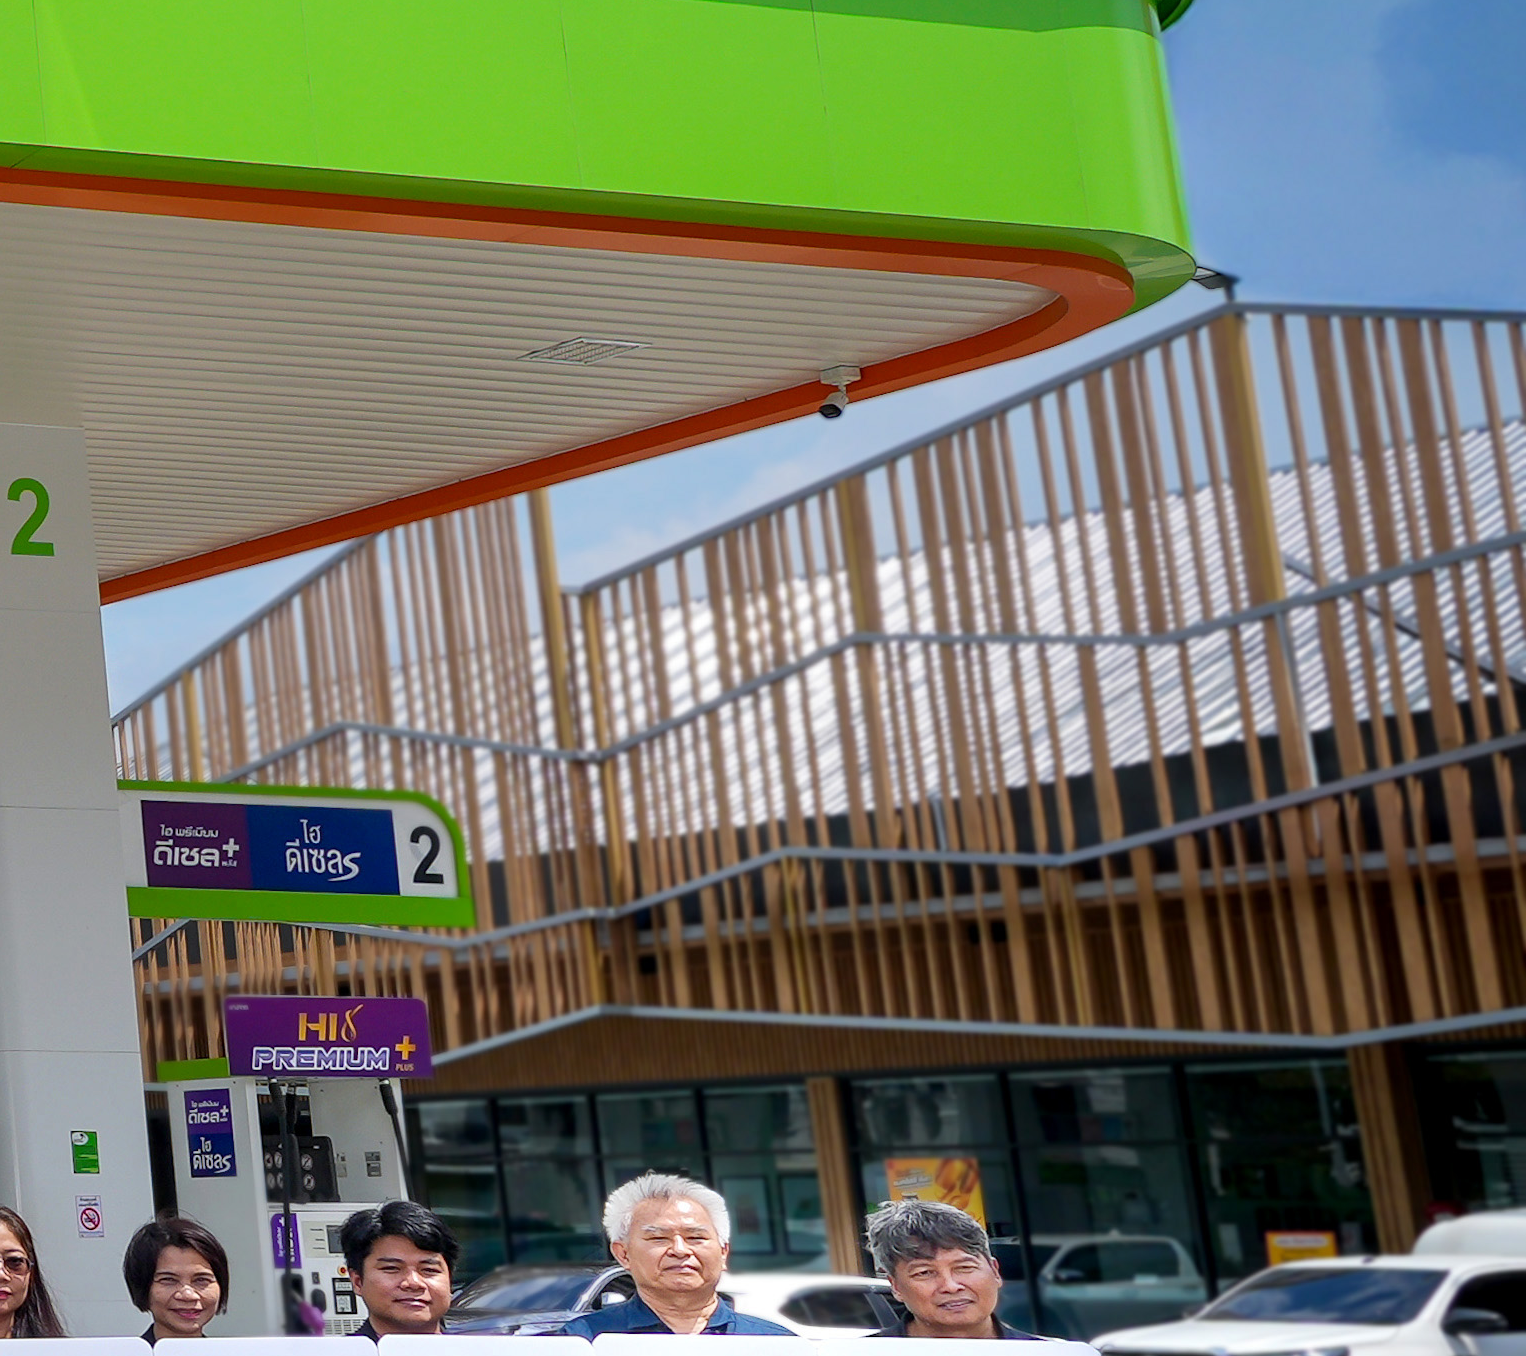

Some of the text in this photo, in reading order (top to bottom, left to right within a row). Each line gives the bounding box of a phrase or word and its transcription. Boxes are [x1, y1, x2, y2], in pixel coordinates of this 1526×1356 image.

[7, 477, 55, 557] 2
[300, 819, 321, 844] ไฮ
[410, 826, 445, 885] 2
[252, 1046, 391, 1071] PREMIUM
[395, 1063, 415, 1071] PLUS
